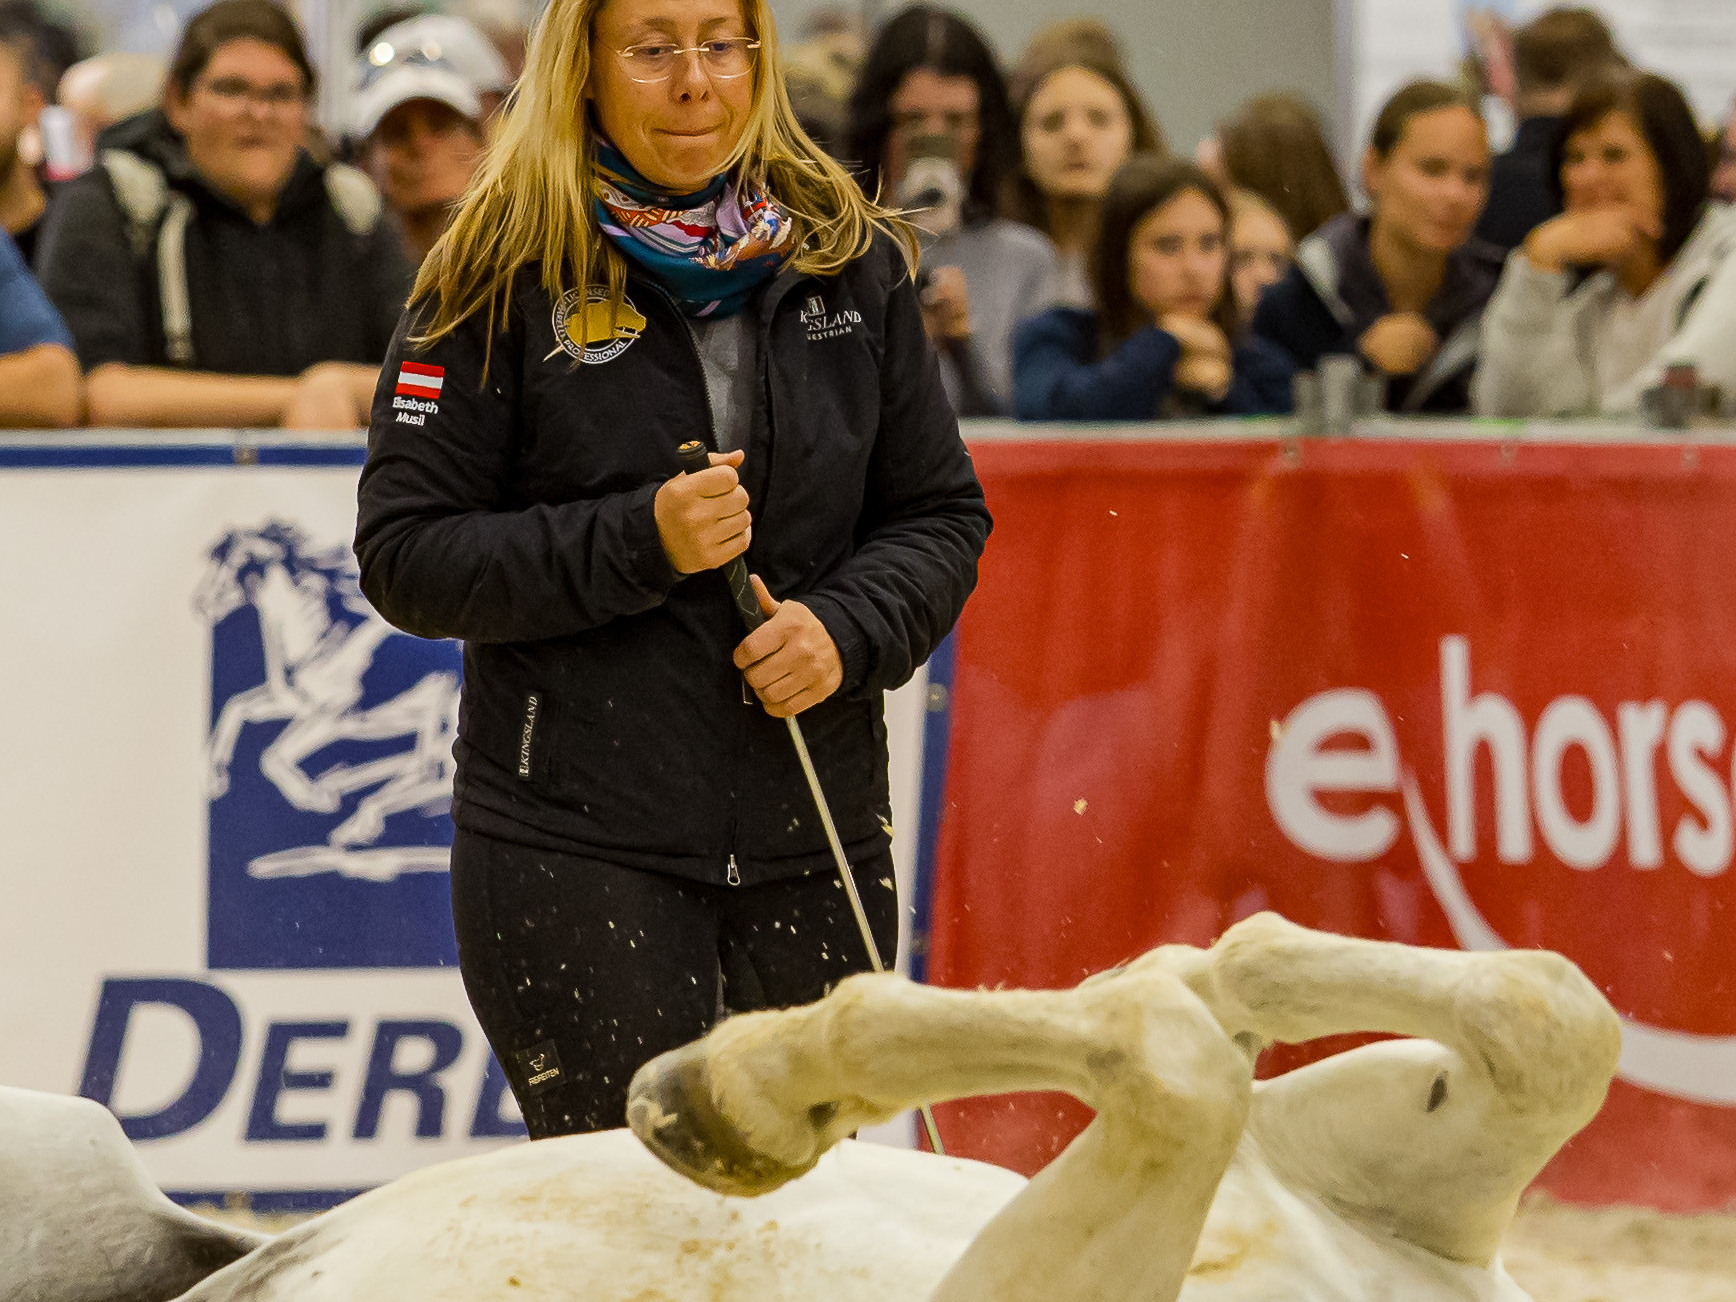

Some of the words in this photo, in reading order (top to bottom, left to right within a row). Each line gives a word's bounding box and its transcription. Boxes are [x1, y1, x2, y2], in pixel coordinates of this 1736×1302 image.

[563, 339, 627, 362] PROESSIONAL
[395, 411, 426, 426] Musil
[521, 696, 538, 767] KINGSLAND
